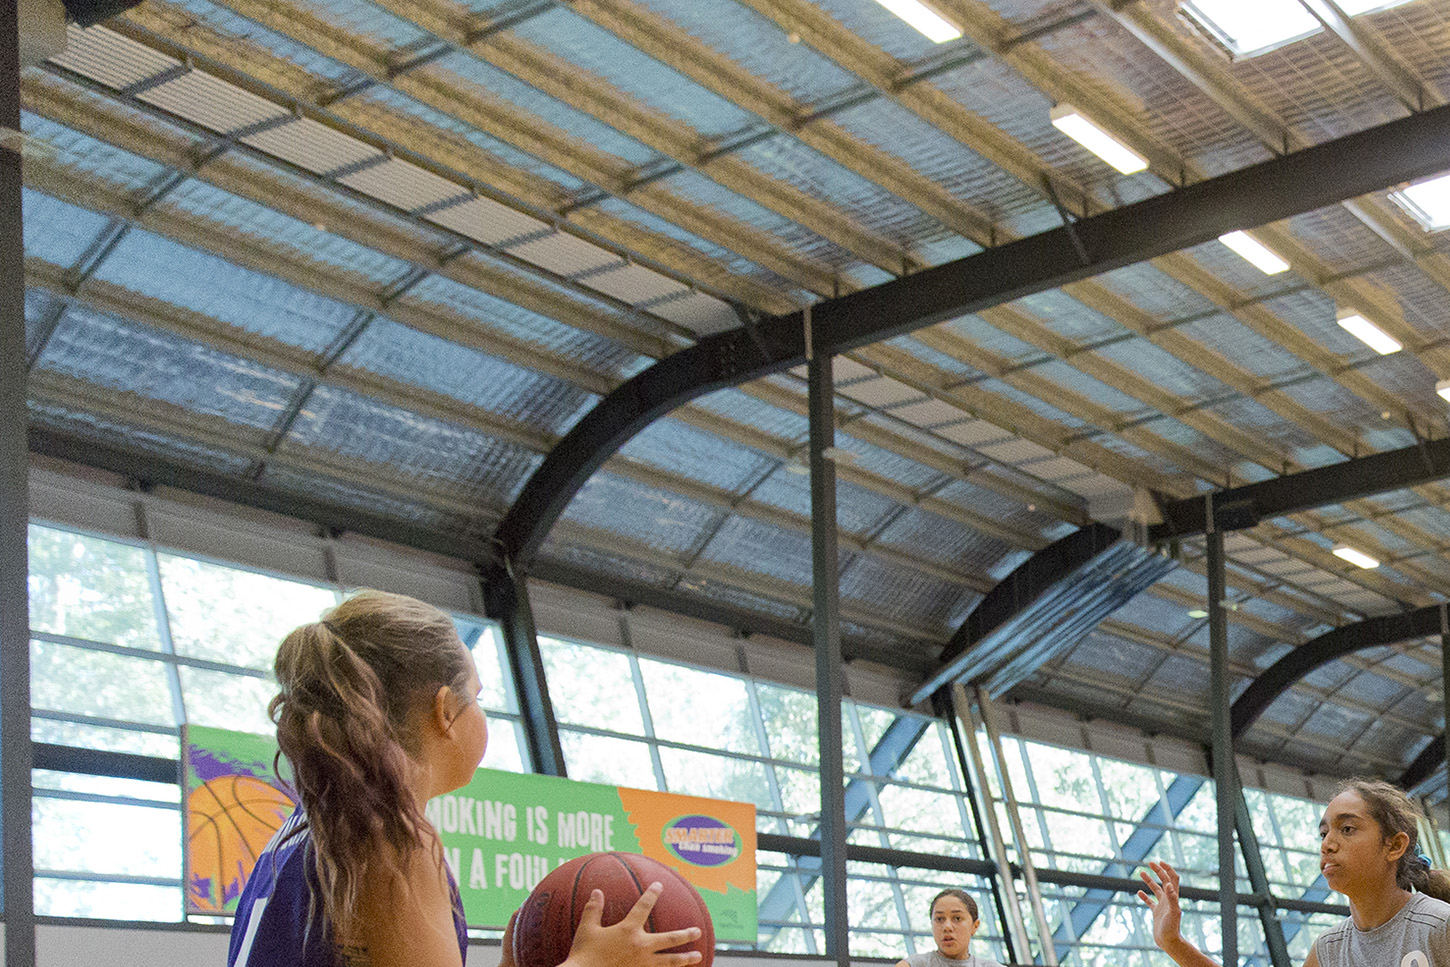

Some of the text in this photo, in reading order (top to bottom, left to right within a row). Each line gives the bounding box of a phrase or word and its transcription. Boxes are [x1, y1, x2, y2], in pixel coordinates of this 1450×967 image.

[425, 795, 614, 852] MOKING IS MORE
[664, 827, 734, 844] SMARTER
[469, 848, 488, 890] A
